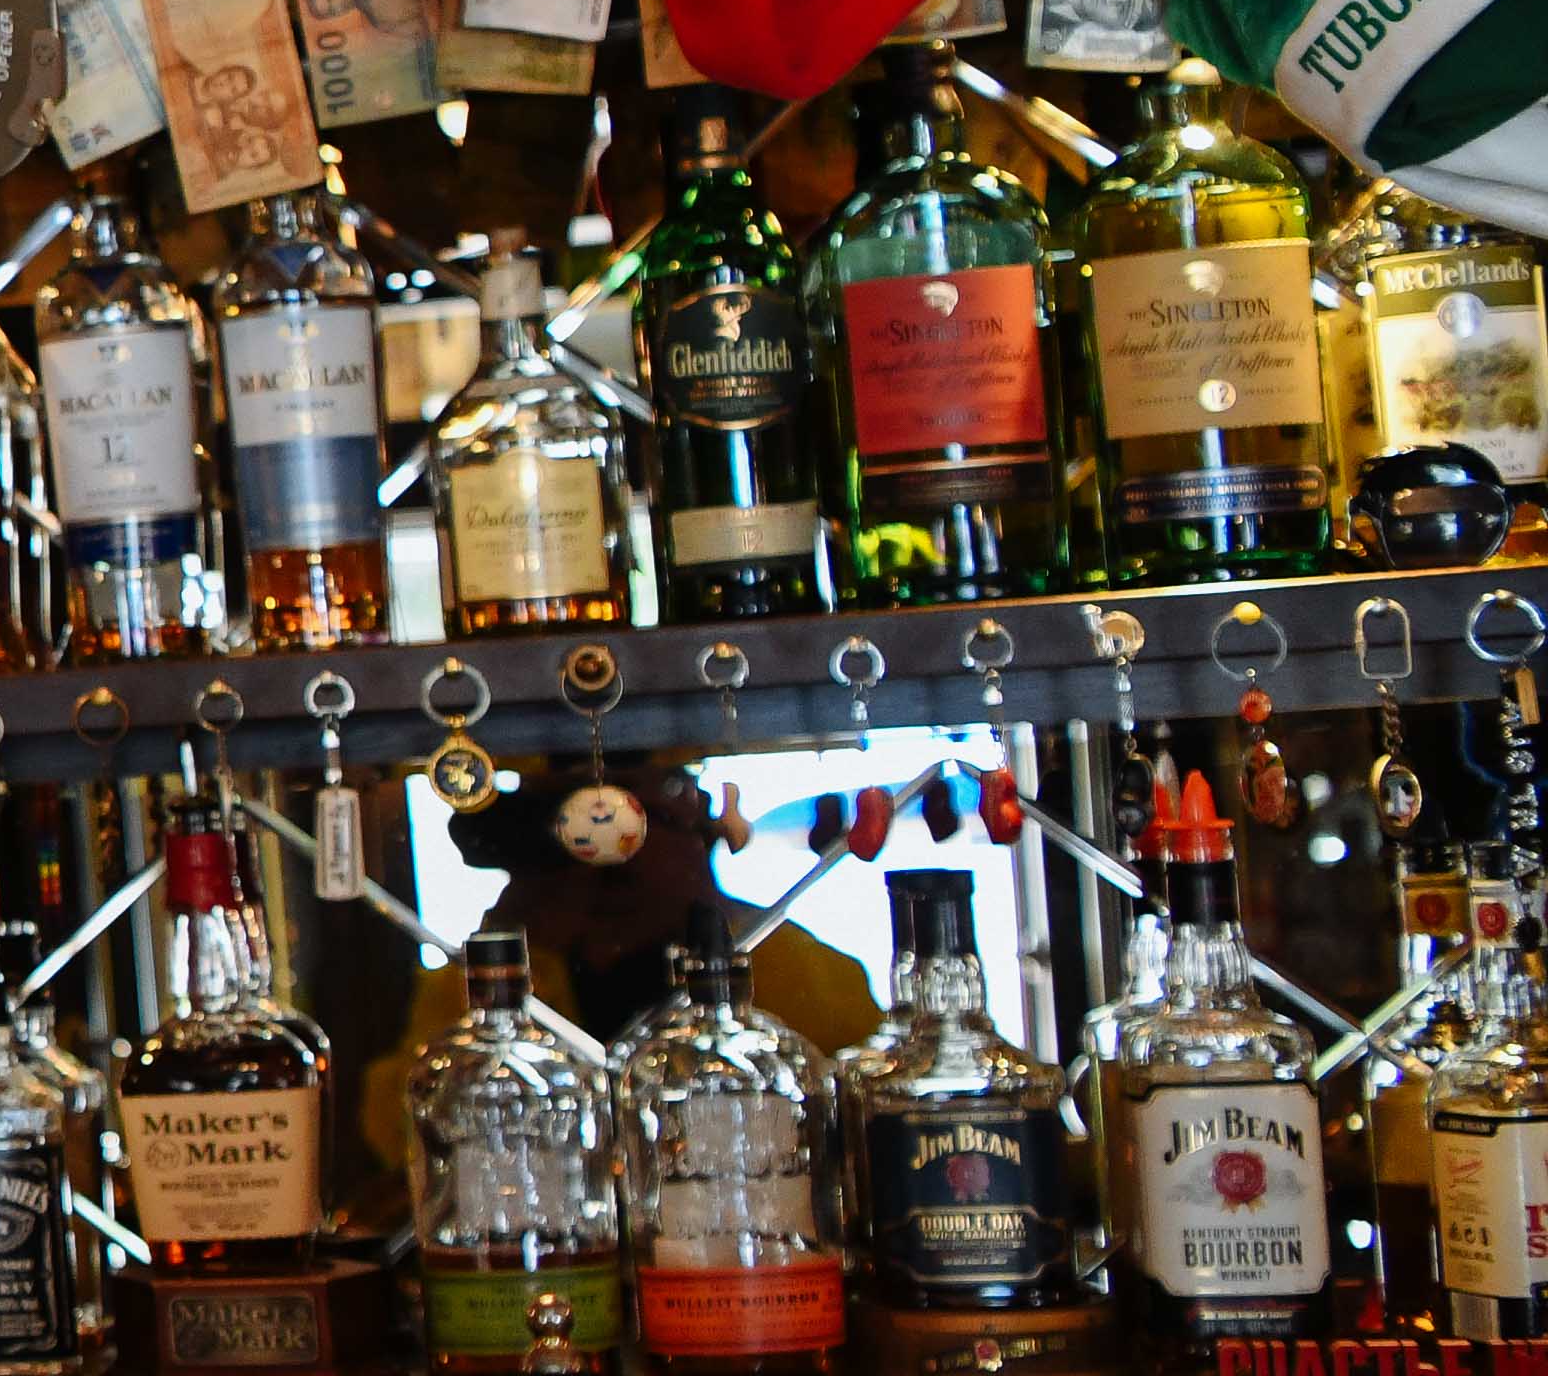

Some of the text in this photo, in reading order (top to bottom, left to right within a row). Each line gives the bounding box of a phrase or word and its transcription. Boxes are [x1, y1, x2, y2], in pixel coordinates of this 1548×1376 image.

[324, 27, 361, 116] 1000
[1382, 257, 1530, 296] McClelland's
[1149, 297, 1272, 328] SINGLETON
[668, 338, 794, 378] Glenfiddich
[235, 361, 369, 395] MACALLAN
[57, 384, 176, 416] MACALLAN
[1208, 386, 1231, 405] 12
[101, 433, 136, 468] 12
[142, 1111, 290, 1137] Maker's
[1164, 1107, 1306, 1165] JIM BEAM
[186, 1140, 292, 1166] Mark
[911, 1123, 1022, 1171] JIM BEAM
[917, 1213, 1027, 1233] DOUBLE OAK
[1183, 1224, 1301, 1240] KENTUCKY STRAIGHT
[1183, 1240, 1303, 1268] BOURBON
[1219, 1270, 1272, 1282] WHISKEY
[175, 1303, 308, 1325] Maker's
[217, 1326, 305, 1349] Mark
